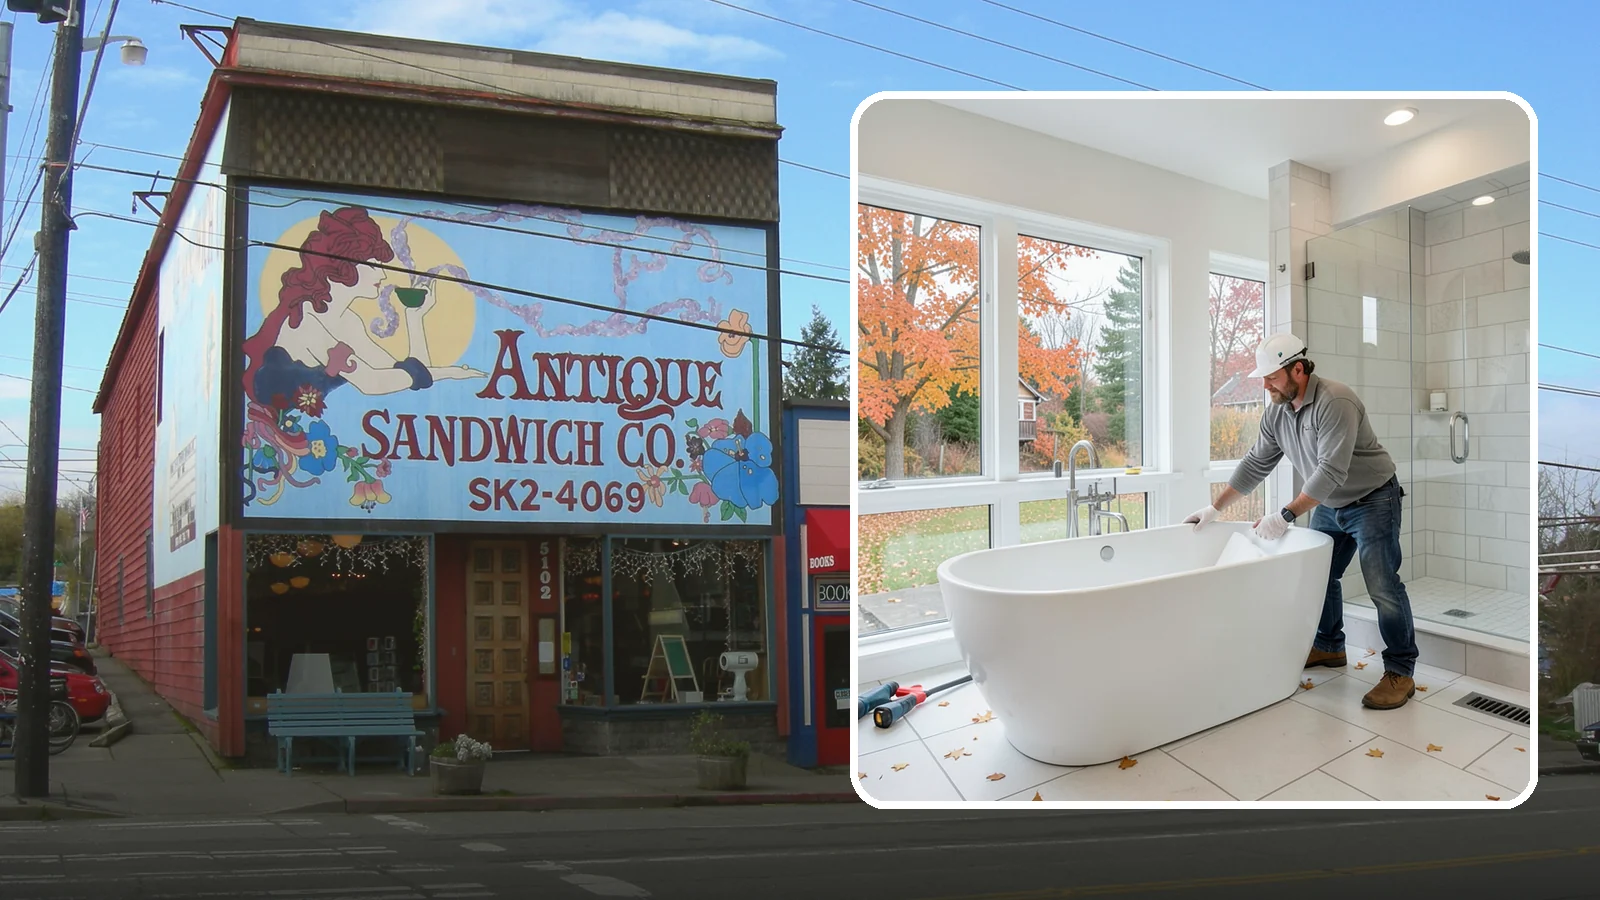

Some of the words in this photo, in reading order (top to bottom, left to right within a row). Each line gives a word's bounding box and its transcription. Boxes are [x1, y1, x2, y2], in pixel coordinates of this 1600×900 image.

[361, 409, 604, 467] SANDWICH
[617, 421, 685, 469] CO.
[468, 476, 646, 512] SK2-4069
[540, 542, 552, 600] 5102
[809, 555, 835, 569] BOOKS
